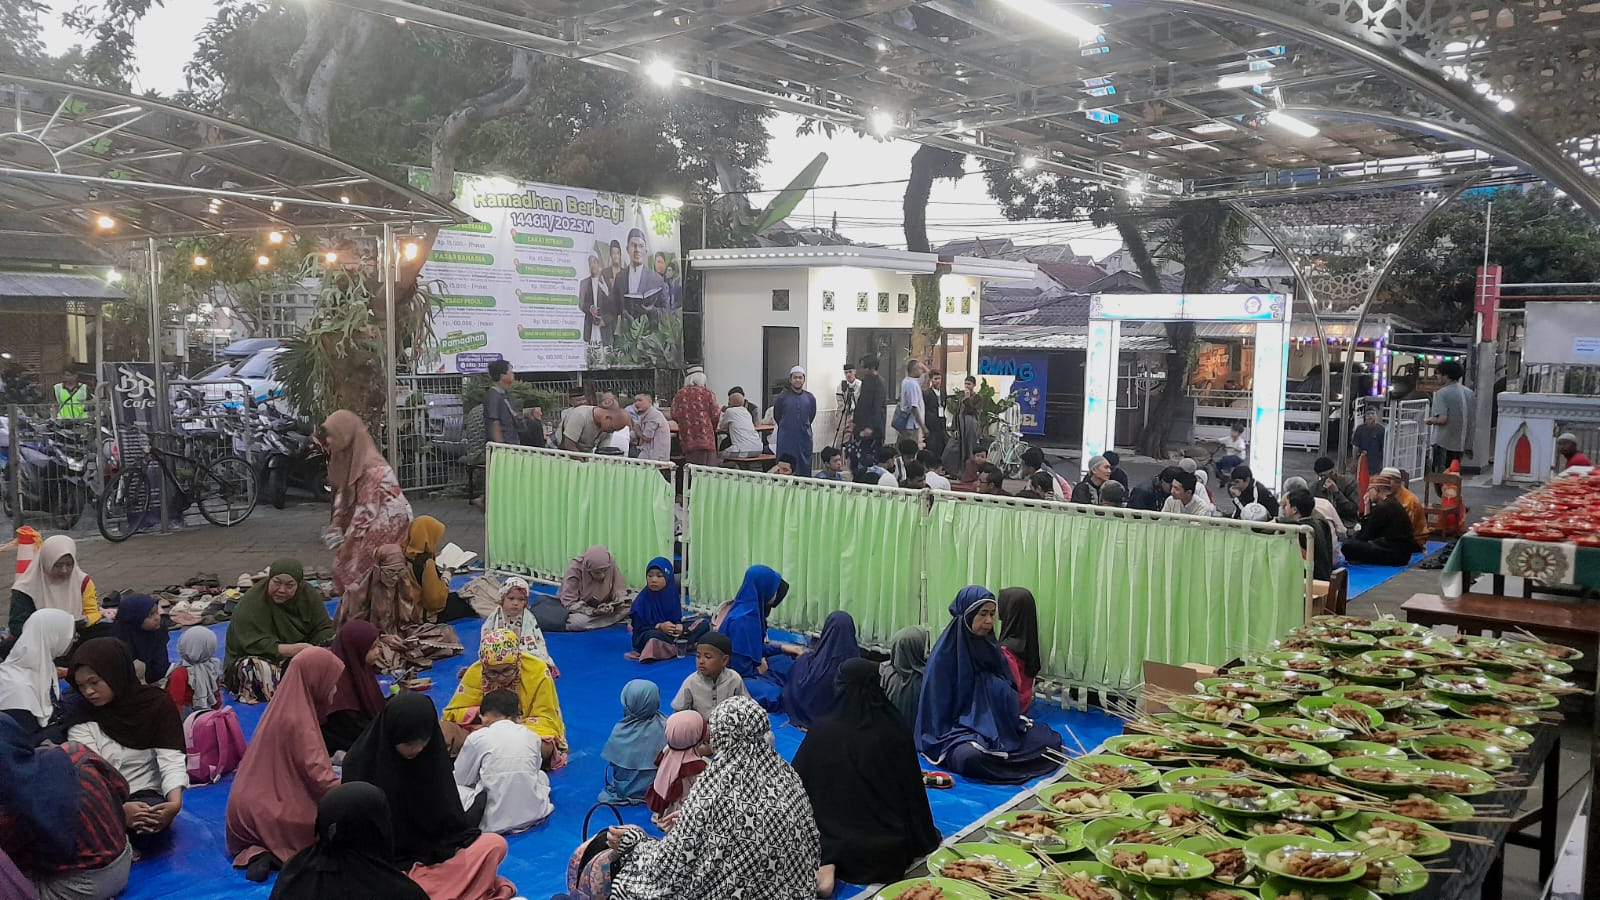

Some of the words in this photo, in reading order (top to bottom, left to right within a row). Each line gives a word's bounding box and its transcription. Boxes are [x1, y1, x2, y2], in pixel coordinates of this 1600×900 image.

[474, 190, 562, 212] Ramadhan
[566, 195, 625, 225] Berbagi
[511, 212, 595, 234] 1446H/2025M
[442, 334, 485, 348] Ramadhan
[123, 398, 156, 410] Cafe
